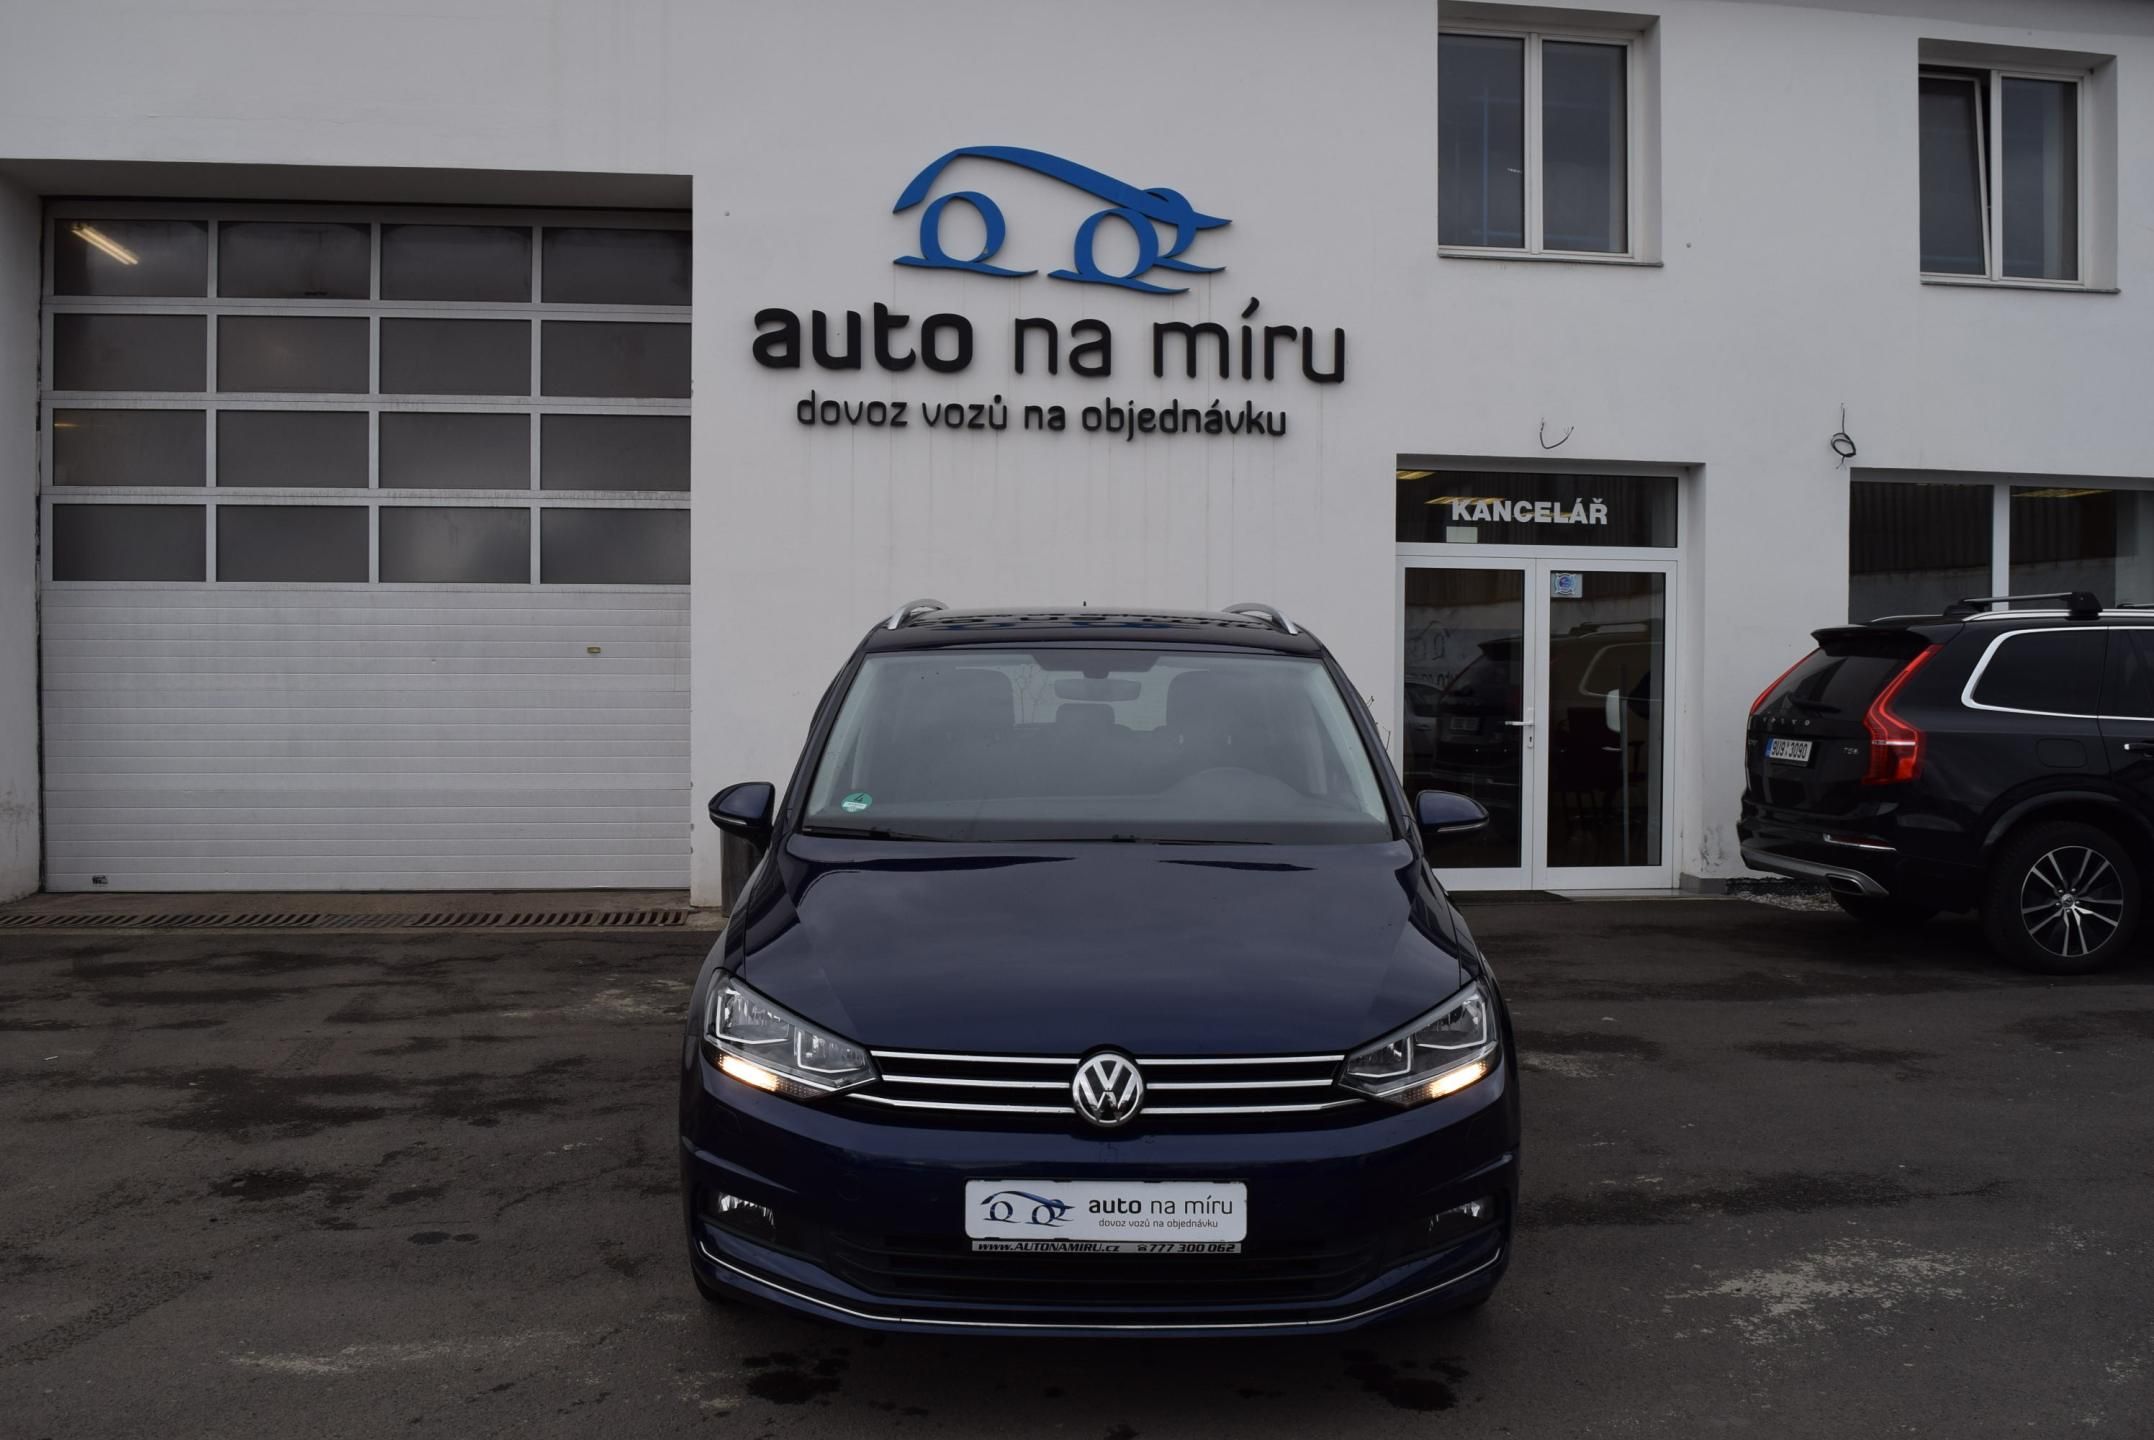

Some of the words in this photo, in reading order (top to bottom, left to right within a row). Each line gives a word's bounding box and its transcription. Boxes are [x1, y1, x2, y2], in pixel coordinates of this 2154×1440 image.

[752, 301, 974, 376] auto
[1014, 317, 1112, 380] na
[1152, 296, 1346, 386] míru
[796, 389, 909, 430] dovoz
[921, 394, 1008, 433] vozů
[1023, 405, 1067, 433] na
[1081, 396, 1287, 443] objednávku
[1452, 497, 1608, 525] KANCELÁŘ
[1088, 1197, 1142, 1215] auto
[1150, 1200, 1176, 1215] na
[1184, 1194, 1233, 1215] míru
[1098, 1217, 1126, 1228] dovoz
[1128, 1218, 1151, 1228] vozů
[1152, 1220, 1165, 1228] na
[1166, 1218, 1219, 1230] objednávku
[977, 1242, 1120, 1253] www.AUTONAMIRU.cz
[1148, 1243, 1176, 1253] 777
[1178, 1243, 1205, 1253] 300
[1207, 1244, 1236, 1253] 062
